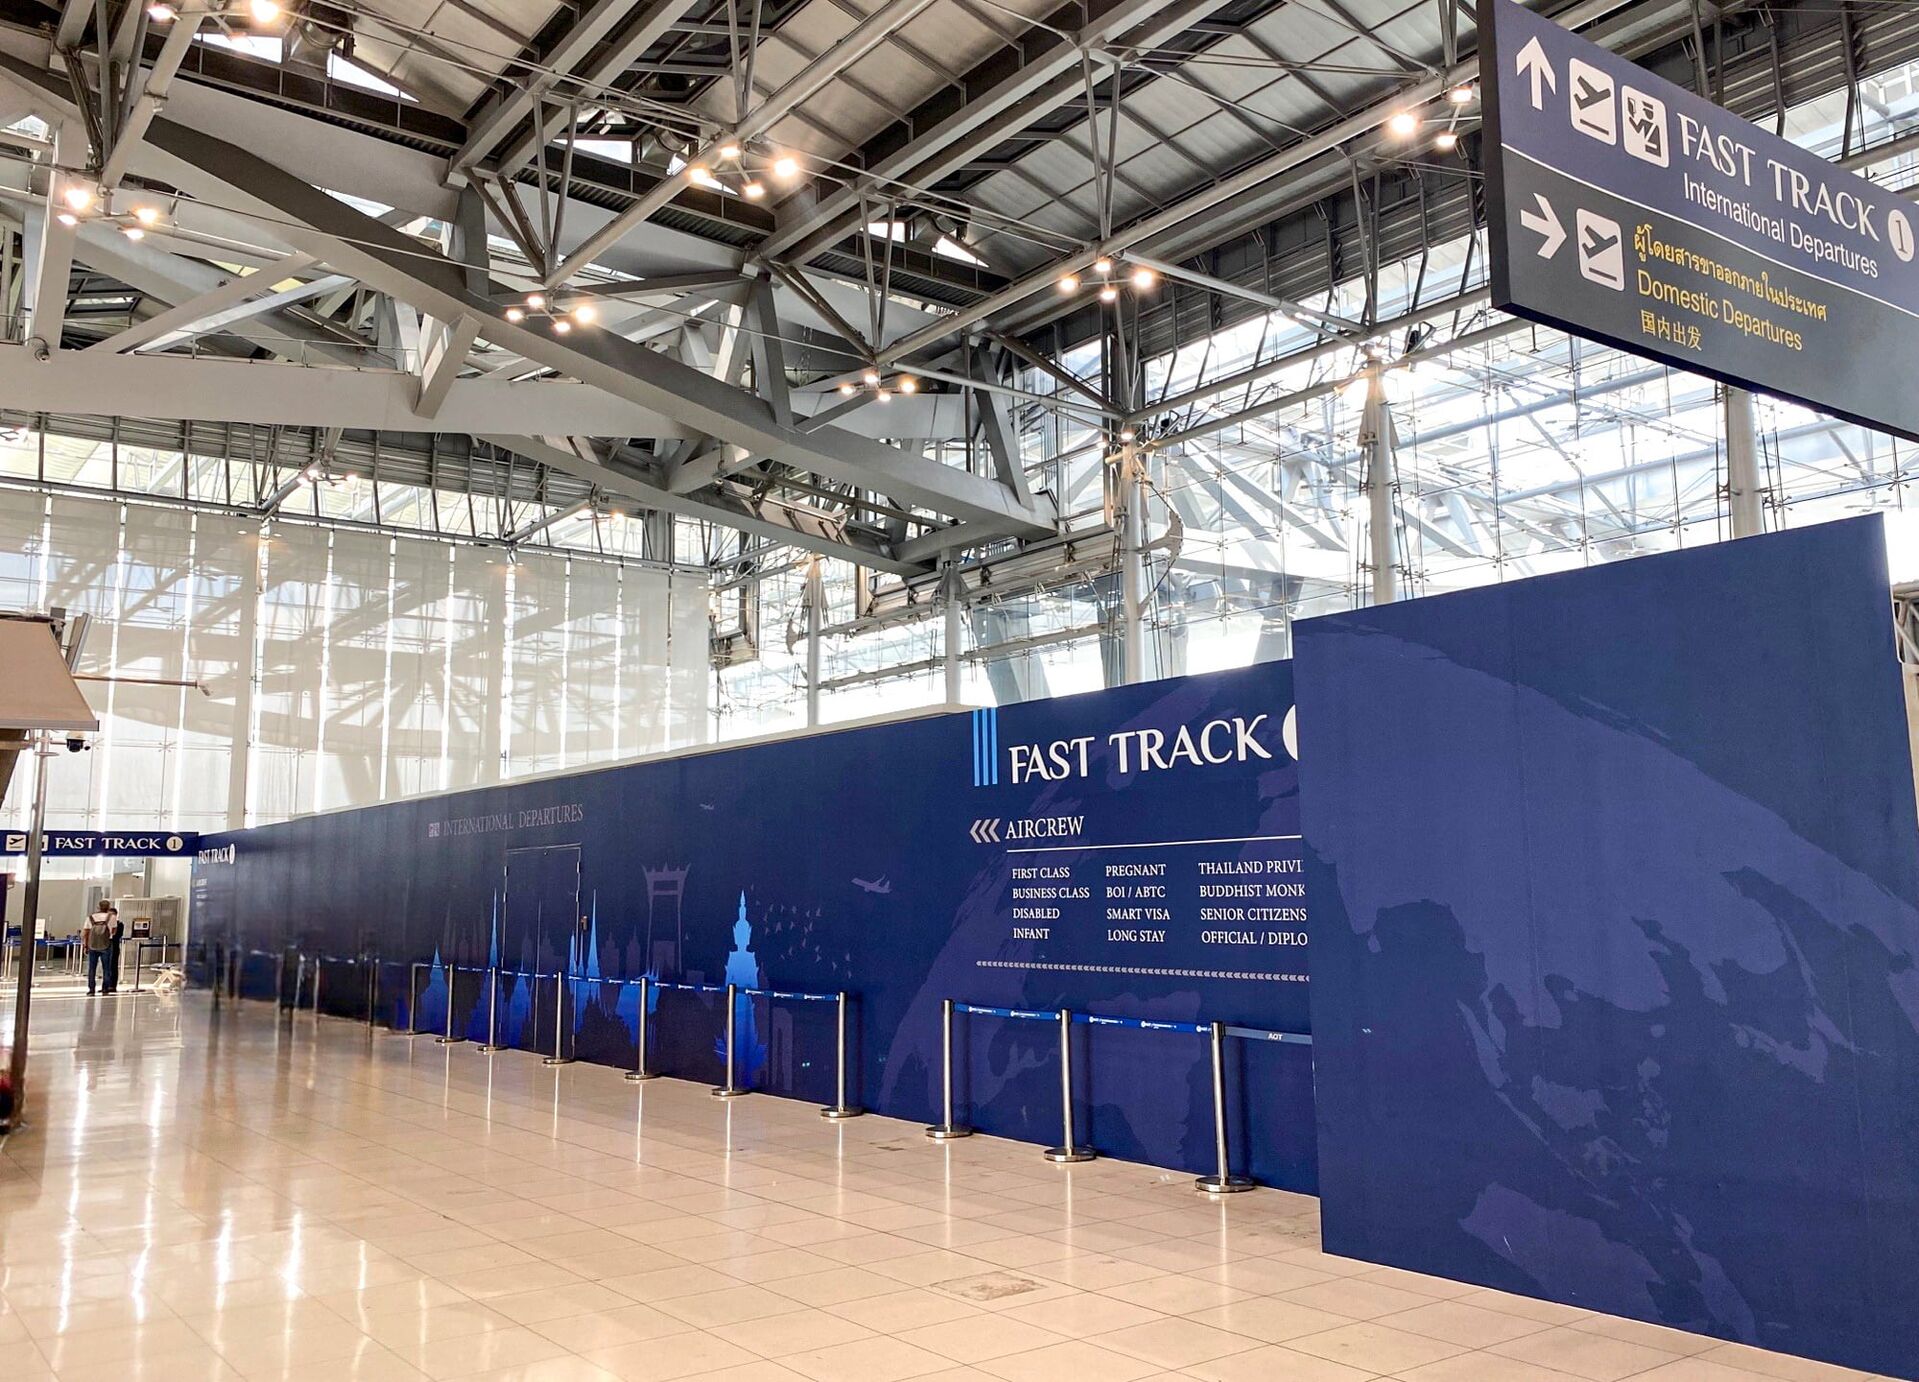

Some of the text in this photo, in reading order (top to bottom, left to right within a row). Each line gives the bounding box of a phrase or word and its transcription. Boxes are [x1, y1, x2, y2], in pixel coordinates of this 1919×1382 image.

[1676, 112, 1756, 188] FAST
[1767, 158, 1881, 242] TRACK
[1683, 172, 1879, 279] International Departures
[1633, 224, 1827, 322] ผู้โดยสารขาออกภายในประเทศ
[1637, 269, 1803, 351] Domestic Departures
[1640, 309, 1702, 351] 国内出发
[1008, 714, 1272, 784] FAST TRACK
[443, 803, 584, 836] INTERNATIONAL DEPARTURES
[1005, 815, 1085, 840] AIRCREW
[55, 837, 96, 849] FAST
[102, 837, 161, 850] TRACK
[1012, 866, 1070, 879] FIRST CLASS
[1105, 864, 1167, 877] PREGNANT
[1198, 859, 1304, 875] THAILAND PRIVI
[1012, 887, 1090, 899] BUSINESS CLASS
[1106, 886, 1125, 898] BOI
[1135, 885, 1166, 898] ABTC
[1199, 884, 1262, 898] BUDDHIST
[1013, 907, 1060, 919] DISABLED
[1106, 908, 1171, 920] SMART VISA
[1200, 907, 1307, 921] SENIOR CITIZENS
[1013, 927, 1050, 940] INFANT
[1107, 929, 1166, 943] LONG STAY
[1201, 930, 1258, 945] OFFICIAL
[1267, 931, 1308, 946] DIPLO
[1267, 1032, 1283, 1041] AOT
